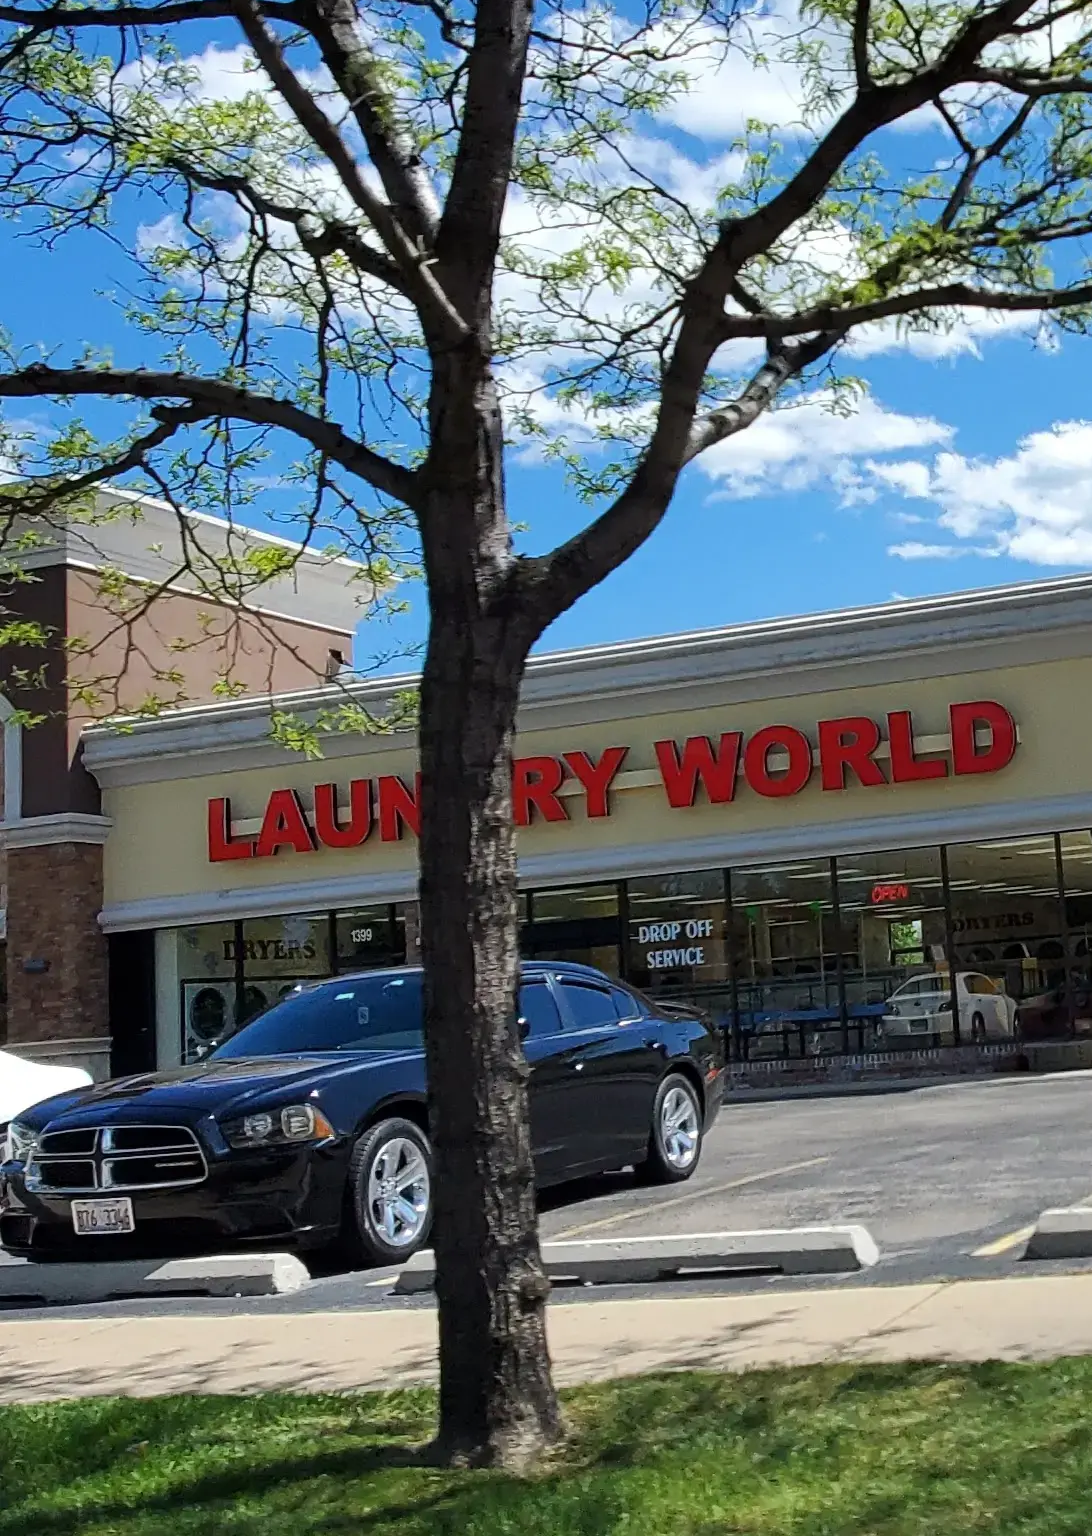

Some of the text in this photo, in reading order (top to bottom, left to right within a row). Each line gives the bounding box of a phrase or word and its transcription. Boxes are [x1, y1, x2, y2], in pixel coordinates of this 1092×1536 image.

[208, 700, 1017, 862] LAUNRY WORLD
[872, 884, 908, 903] OPEN
[351, 928, 372, 943] 1399
[639, 919, 713, 944] DROP OFF
[646, 947, 705, 968] SERVICE
